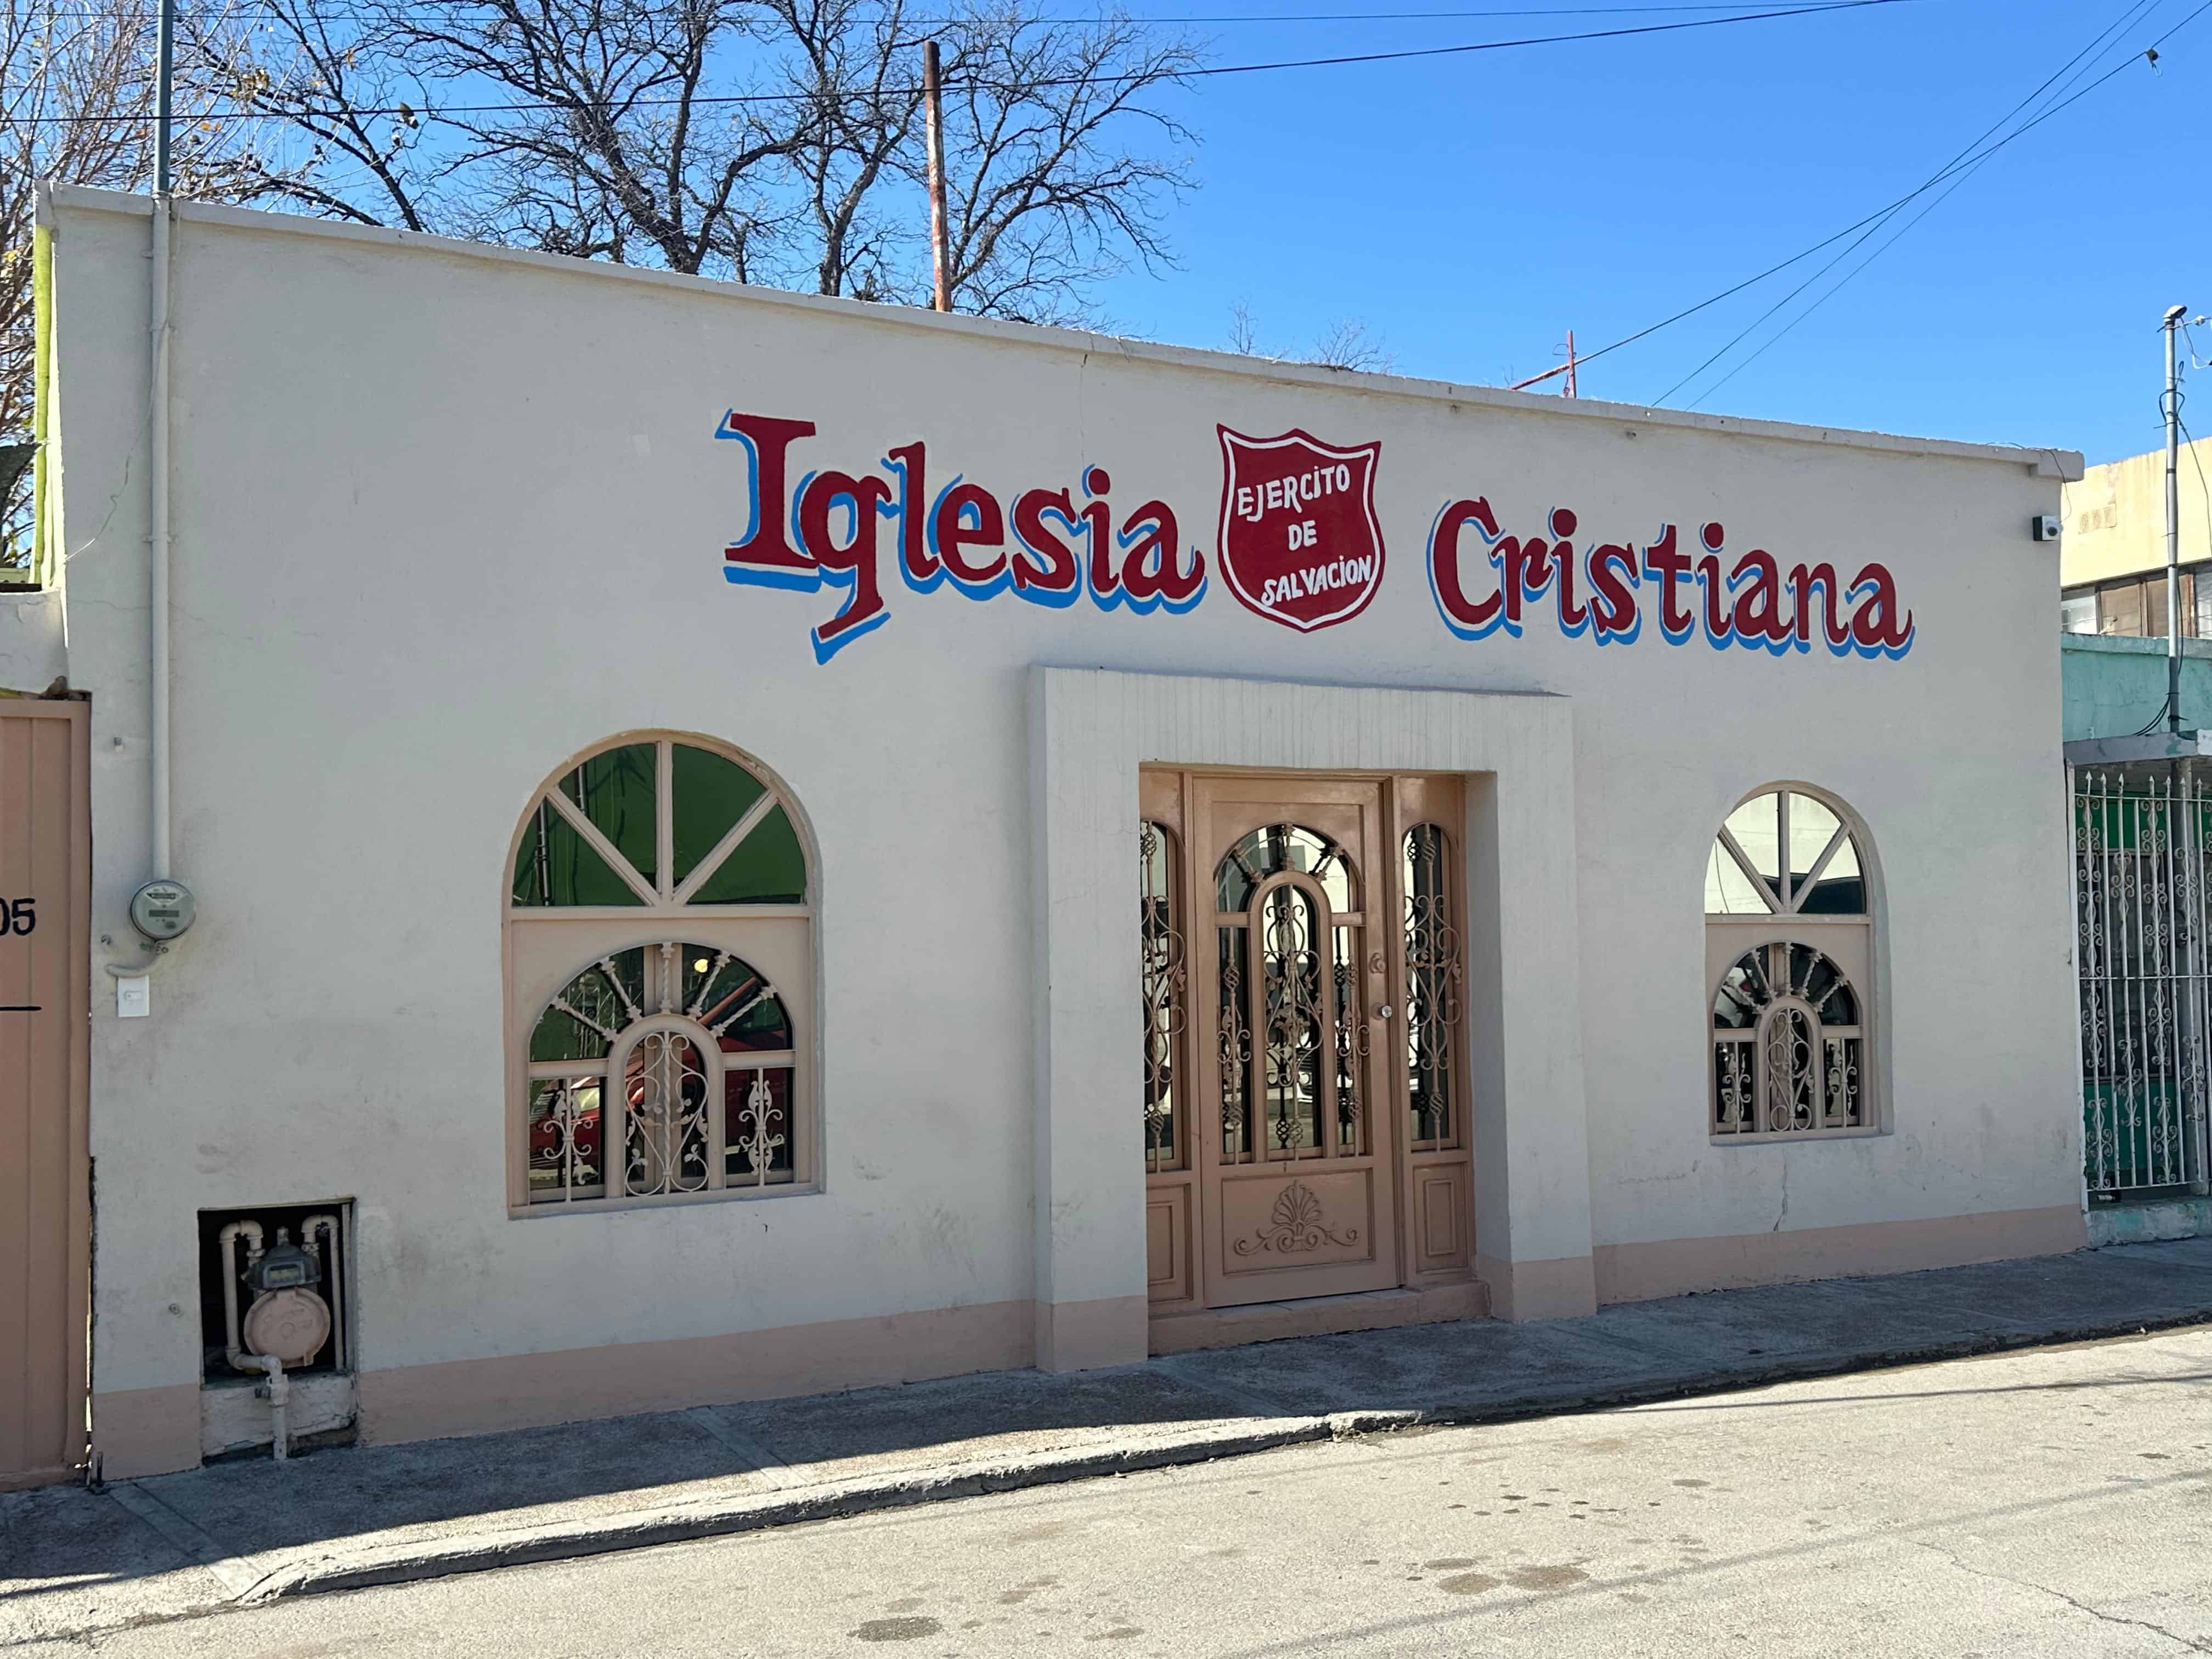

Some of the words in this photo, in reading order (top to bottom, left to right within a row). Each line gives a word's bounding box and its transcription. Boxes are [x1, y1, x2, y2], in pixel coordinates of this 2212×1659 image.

[716, 410, 1207, 663] Iglesia
[1427, 497, 1915, 659] Cristiana
[1288, 520, 1317, 551] DE
